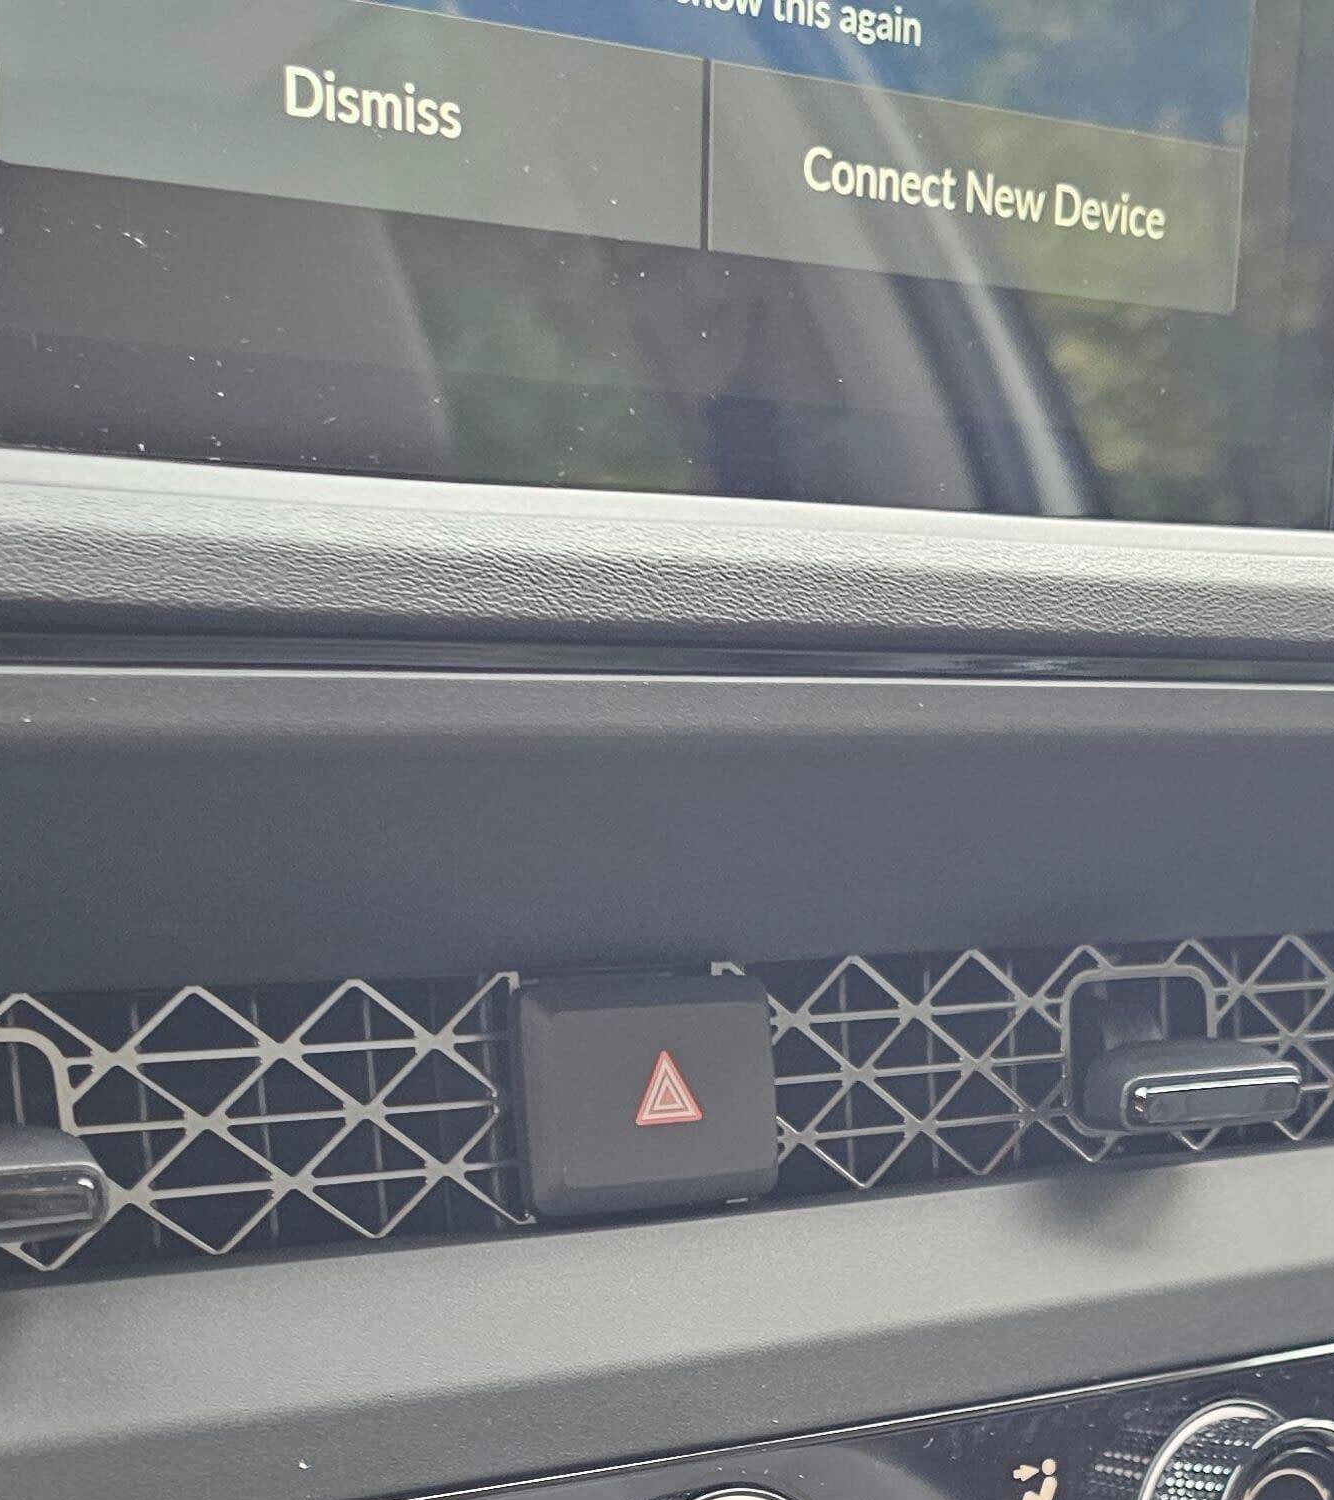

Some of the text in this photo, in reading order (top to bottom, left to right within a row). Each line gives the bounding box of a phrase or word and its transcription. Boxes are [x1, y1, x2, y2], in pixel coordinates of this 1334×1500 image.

[838, 6, 922, 47] again
[284, 64, 463, 139] Dismiss
[803, 146, 1166, 240] Connect New Device
